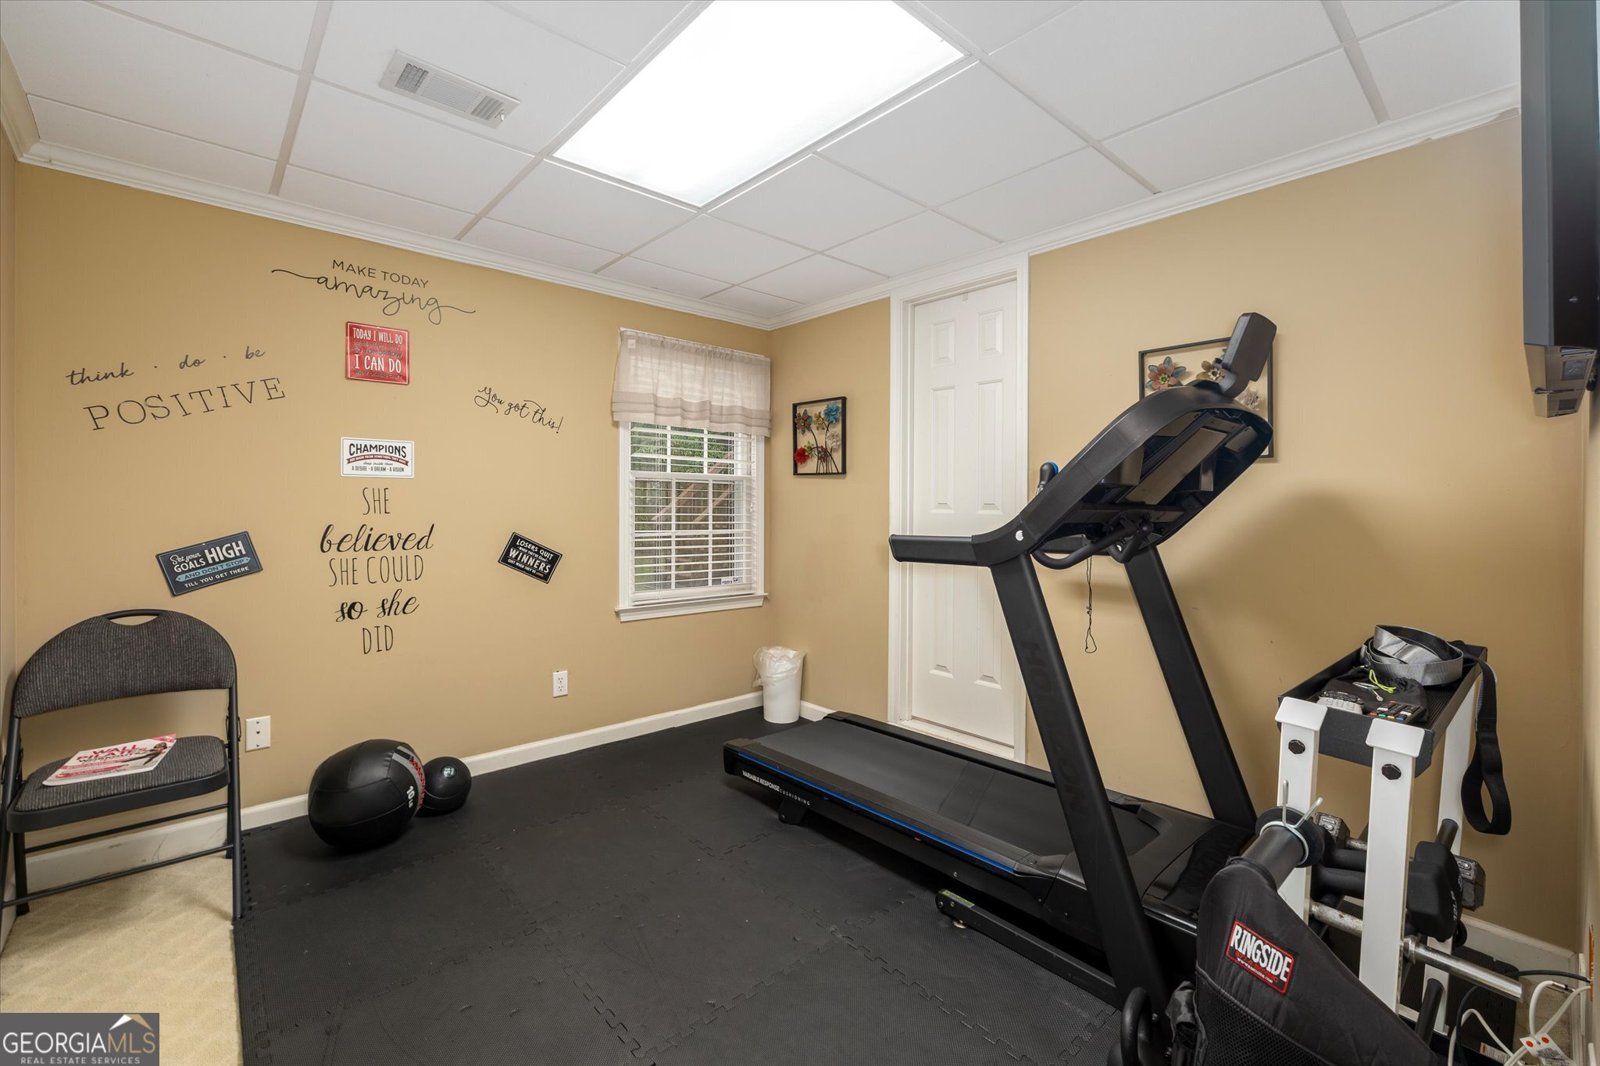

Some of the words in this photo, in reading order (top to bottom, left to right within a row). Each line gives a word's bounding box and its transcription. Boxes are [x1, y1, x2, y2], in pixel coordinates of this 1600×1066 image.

[332, 259, 376, 279] MAKE
[381, 271, 429, 288] TODAY
[272, 269, 476, 325] amazing
[353, 328, 371, 340] TODAY
[373, 330, 376, 341] I
[378, 332, 393, 343] WILL
[395, 334, 402, 344] DO
[65, 362, 134, 385] think
[179, 355, 206, 369] do
[245, 346, 266, 360] be
[355, 354, 360, 369] I
[364, 355, 384, 372] CAN
[389, 358, 402, 373] DO
[83, 378, 285, 431] POSITIVE
[474, 387, 505, 413] You
[504, 403, 530, 418] got
[523, 400, 563, 434] this!
[349, 443, 406, 458] CHAMPIONS
[362, 487, 390, 515] SHE
[320, 523, 435, 553] believed
[516, 539, 539, 552] LOSERS
[540, 550, 554, 560] QUIT
[174, 558, 206, 573] GOALS
[204, 540, 246, 564] HIGH
[230, 566, 249, 575] THERE
[329, 558, 358, 587] SHE
[366, 554, 424, 584] COULD
[509, 548, 551, 573] WINNERS
[184, 571, 200, 580] AND
[335, 601, 368, 622] so
[376, 588, 420, 618] she
[362, 624, 394, 654] DID
[407, 785, 415, 799] 10
[1230, 924, 1292, 982] RINGSIDE
